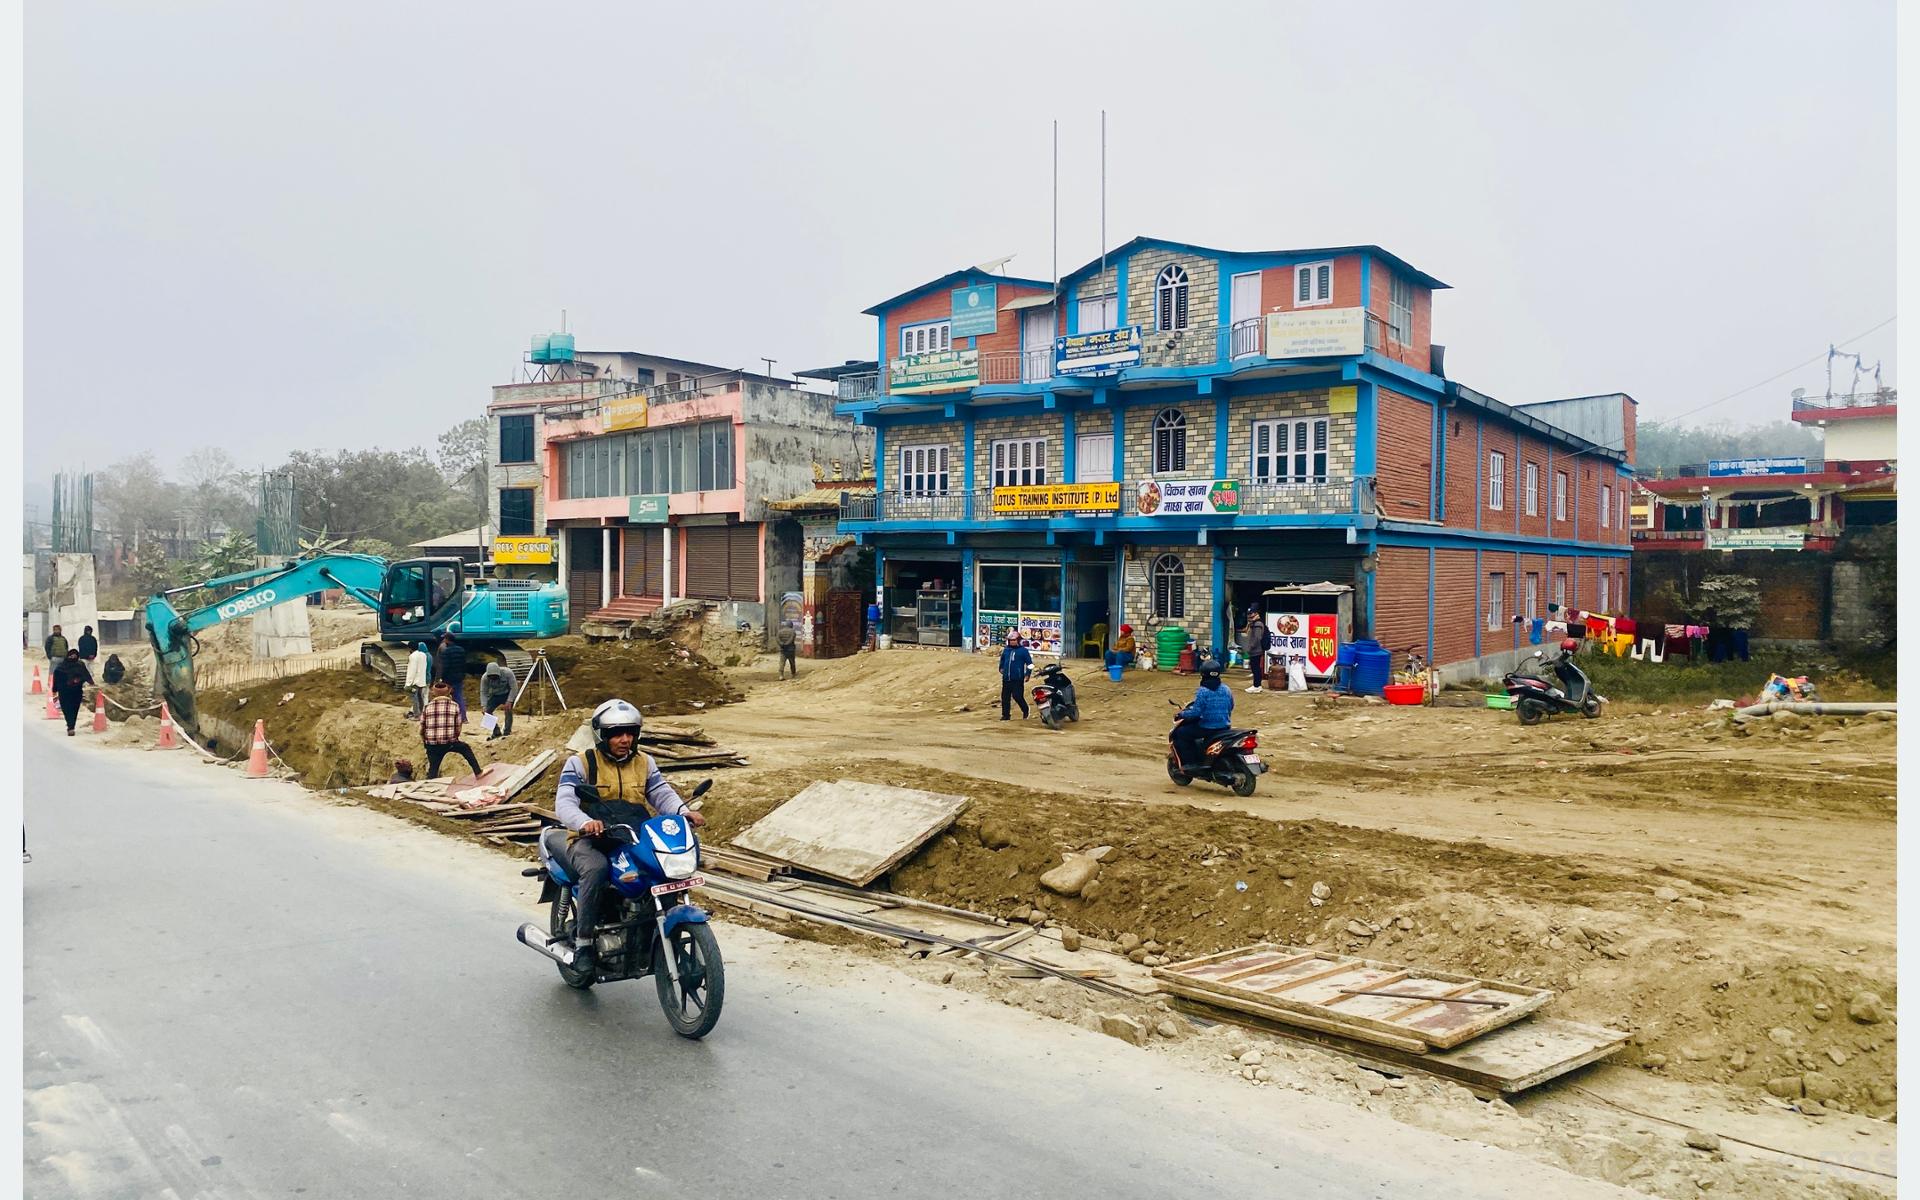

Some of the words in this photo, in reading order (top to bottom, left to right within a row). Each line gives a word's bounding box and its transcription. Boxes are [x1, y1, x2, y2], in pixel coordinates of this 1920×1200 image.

[1089, 333, 1111, 343] मगर
[1114, 329, 1129, 341] संघ
[1164, 483, 1186, 497] चिकन
[1188, 485, 1208, 497] खाना
[994, 494, 1016, 506] LOTUS
[1018, 493, 1049, 505] TRAINING
[1052, 491, 1089, 505] INSTITUTE
[1164, 501, 1182, 512] माछा
[1184, 501, 1203, 512] खाना
[496, 542, 514, 553] PETS
[517, 542, 550, 553] CORNER
[217, 588, 276, 620] KOBELCO
[1315, 626, 1331, 635] मात्र
[1289, 636, 1306, 649] खाना
